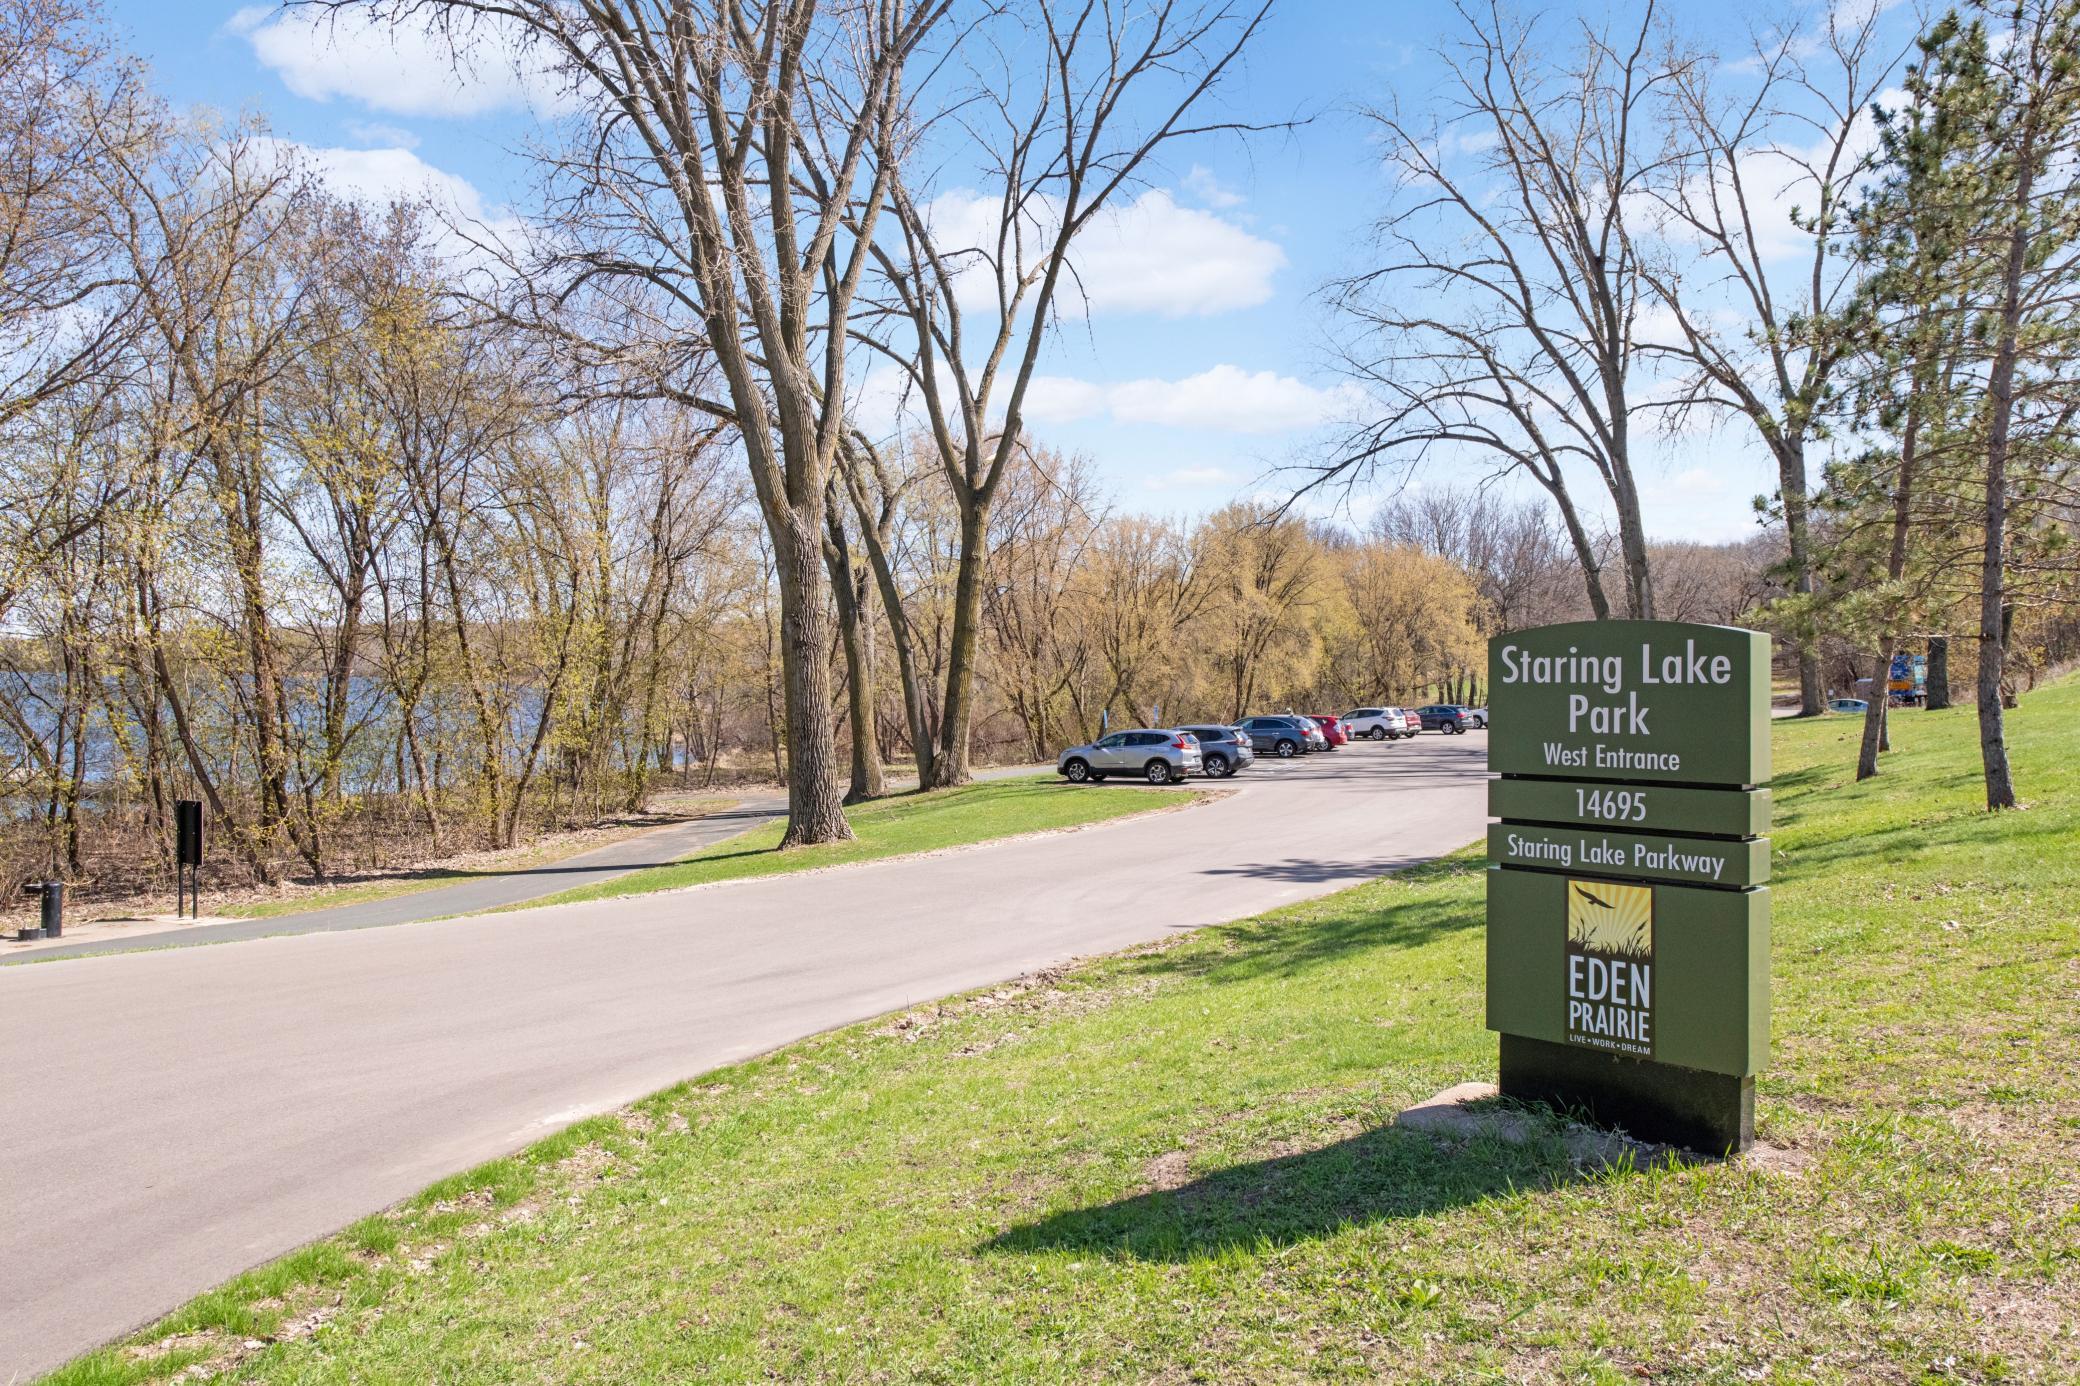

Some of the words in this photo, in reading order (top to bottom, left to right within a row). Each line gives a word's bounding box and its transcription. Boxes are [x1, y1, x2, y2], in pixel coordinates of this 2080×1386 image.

[1501, 645, 1622, 694] Staring
[1642, 639, 1731, 684] Lake
[1569, 691, 1650, 735] Park
[1543, 743, 1587, 767] West
[1595, 744, 1680, 771] Entrance
[1576, 788, 1646, 822] 14695
[1507, 834, 1572, 866] Staring
[1580, 839, 1625, 866] Lake
[1634, 844, 1725, 880] Parkway
[1569, 955, 1649, 1008] EDEN
[1569, 1000, 1649, 1042] PRAIRIE
